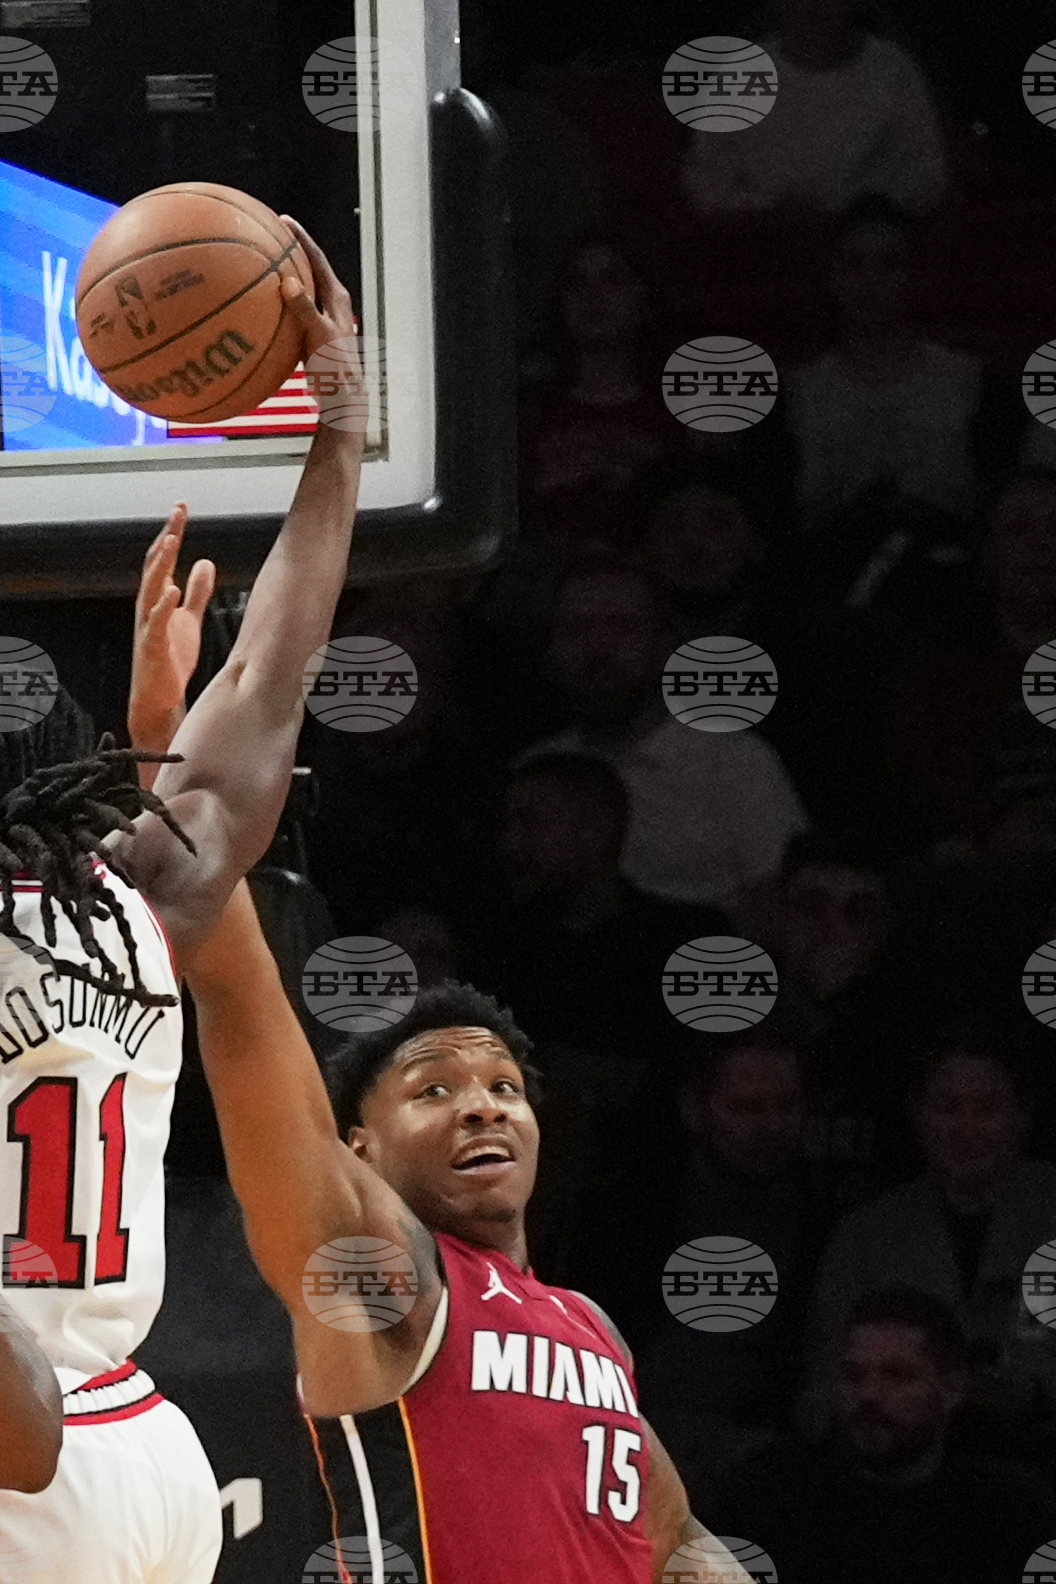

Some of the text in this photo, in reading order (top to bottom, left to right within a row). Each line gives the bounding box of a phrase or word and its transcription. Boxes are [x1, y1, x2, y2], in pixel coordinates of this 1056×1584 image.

[2, 1071, 130, 1290] 11
[470, 1329, 640, 1419] MIAMI
[580, 1423, 643, 1524] 15
